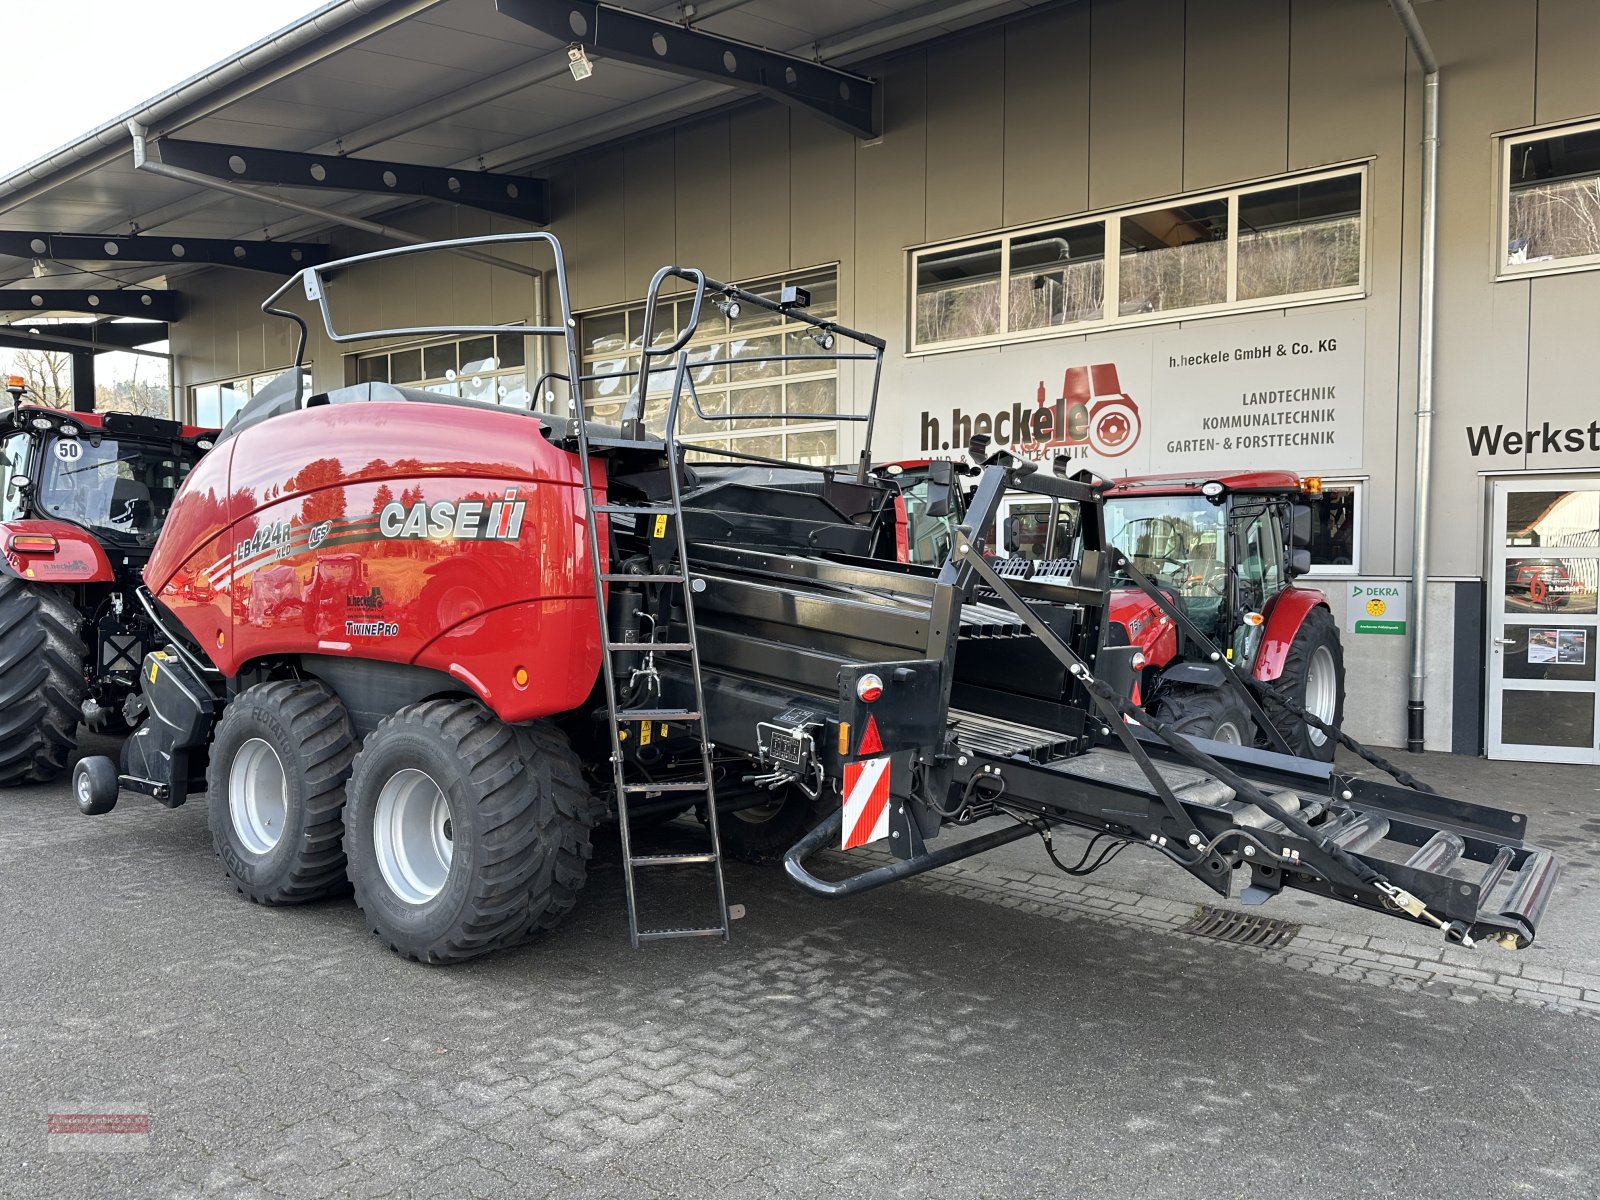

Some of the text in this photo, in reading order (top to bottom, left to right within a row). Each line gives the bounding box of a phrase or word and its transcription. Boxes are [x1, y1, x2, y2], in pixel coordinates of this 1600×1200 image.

[1169, 338, 1337, 368] h.heckele GmbH & Co. KG
[1242, 386, 1336, 406] LANDTECHNIK
[920, 398, 1090, 452] h.heckele
[1202, 408, 1336, 430] KOMMUNALTECHNIK
[1166, 431, 1336, 453] GARTEN- & FORSTTECHNIK
[1466, 420, 1600, 457] Werkst
[58, 443, 78, 458] 50
[379, 501, 484, 538] CASE
[311, 524, 328, 543] AFS
[1366, 587, 1399, 597] DEKRA
